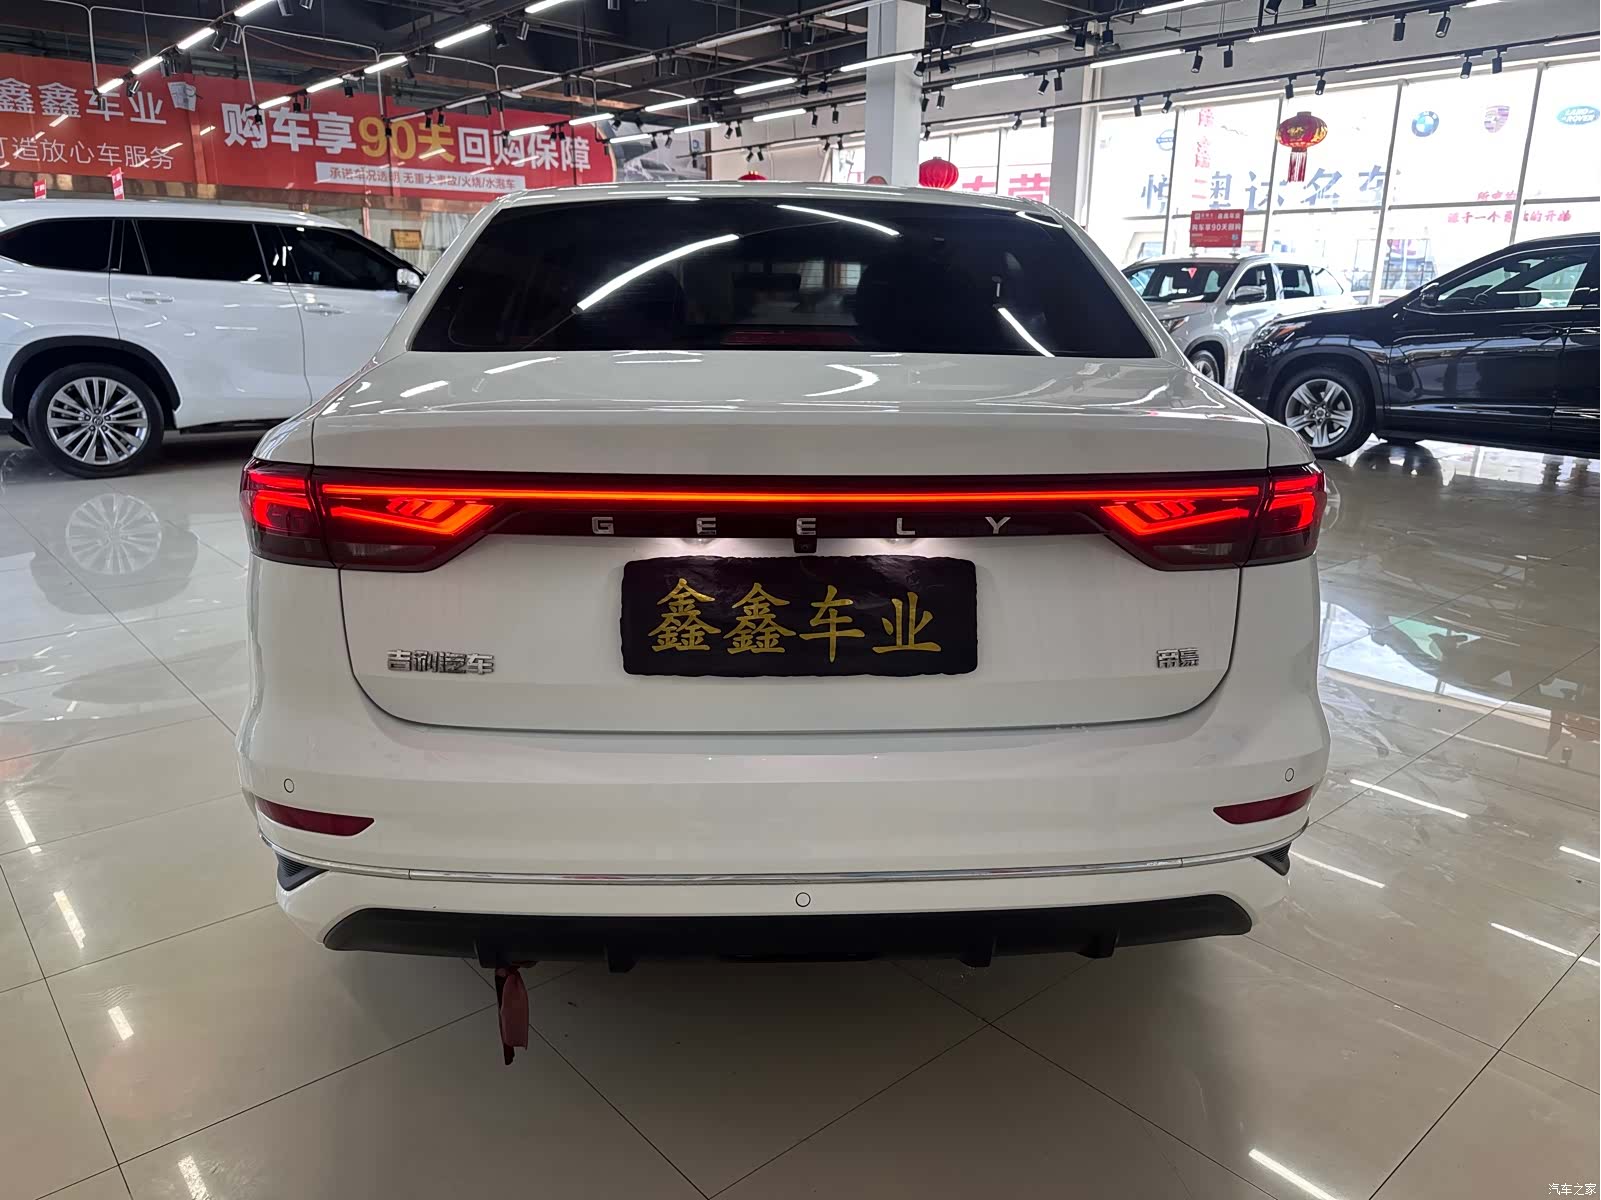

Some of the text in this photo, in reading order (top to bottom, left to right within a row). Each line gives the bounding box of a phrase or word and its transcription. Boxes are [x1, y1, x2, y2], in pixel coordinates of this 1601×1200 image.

[0, 77, 167, 125] 鑫鑫车业
[221, 103, 592, 173] 购车享90天回购保障
[592, 517, 1011, 535] GEELY
[647, 577, 942, 663] 鑫鑫车业
[387, 648, 495, 675] 吉利汽车
